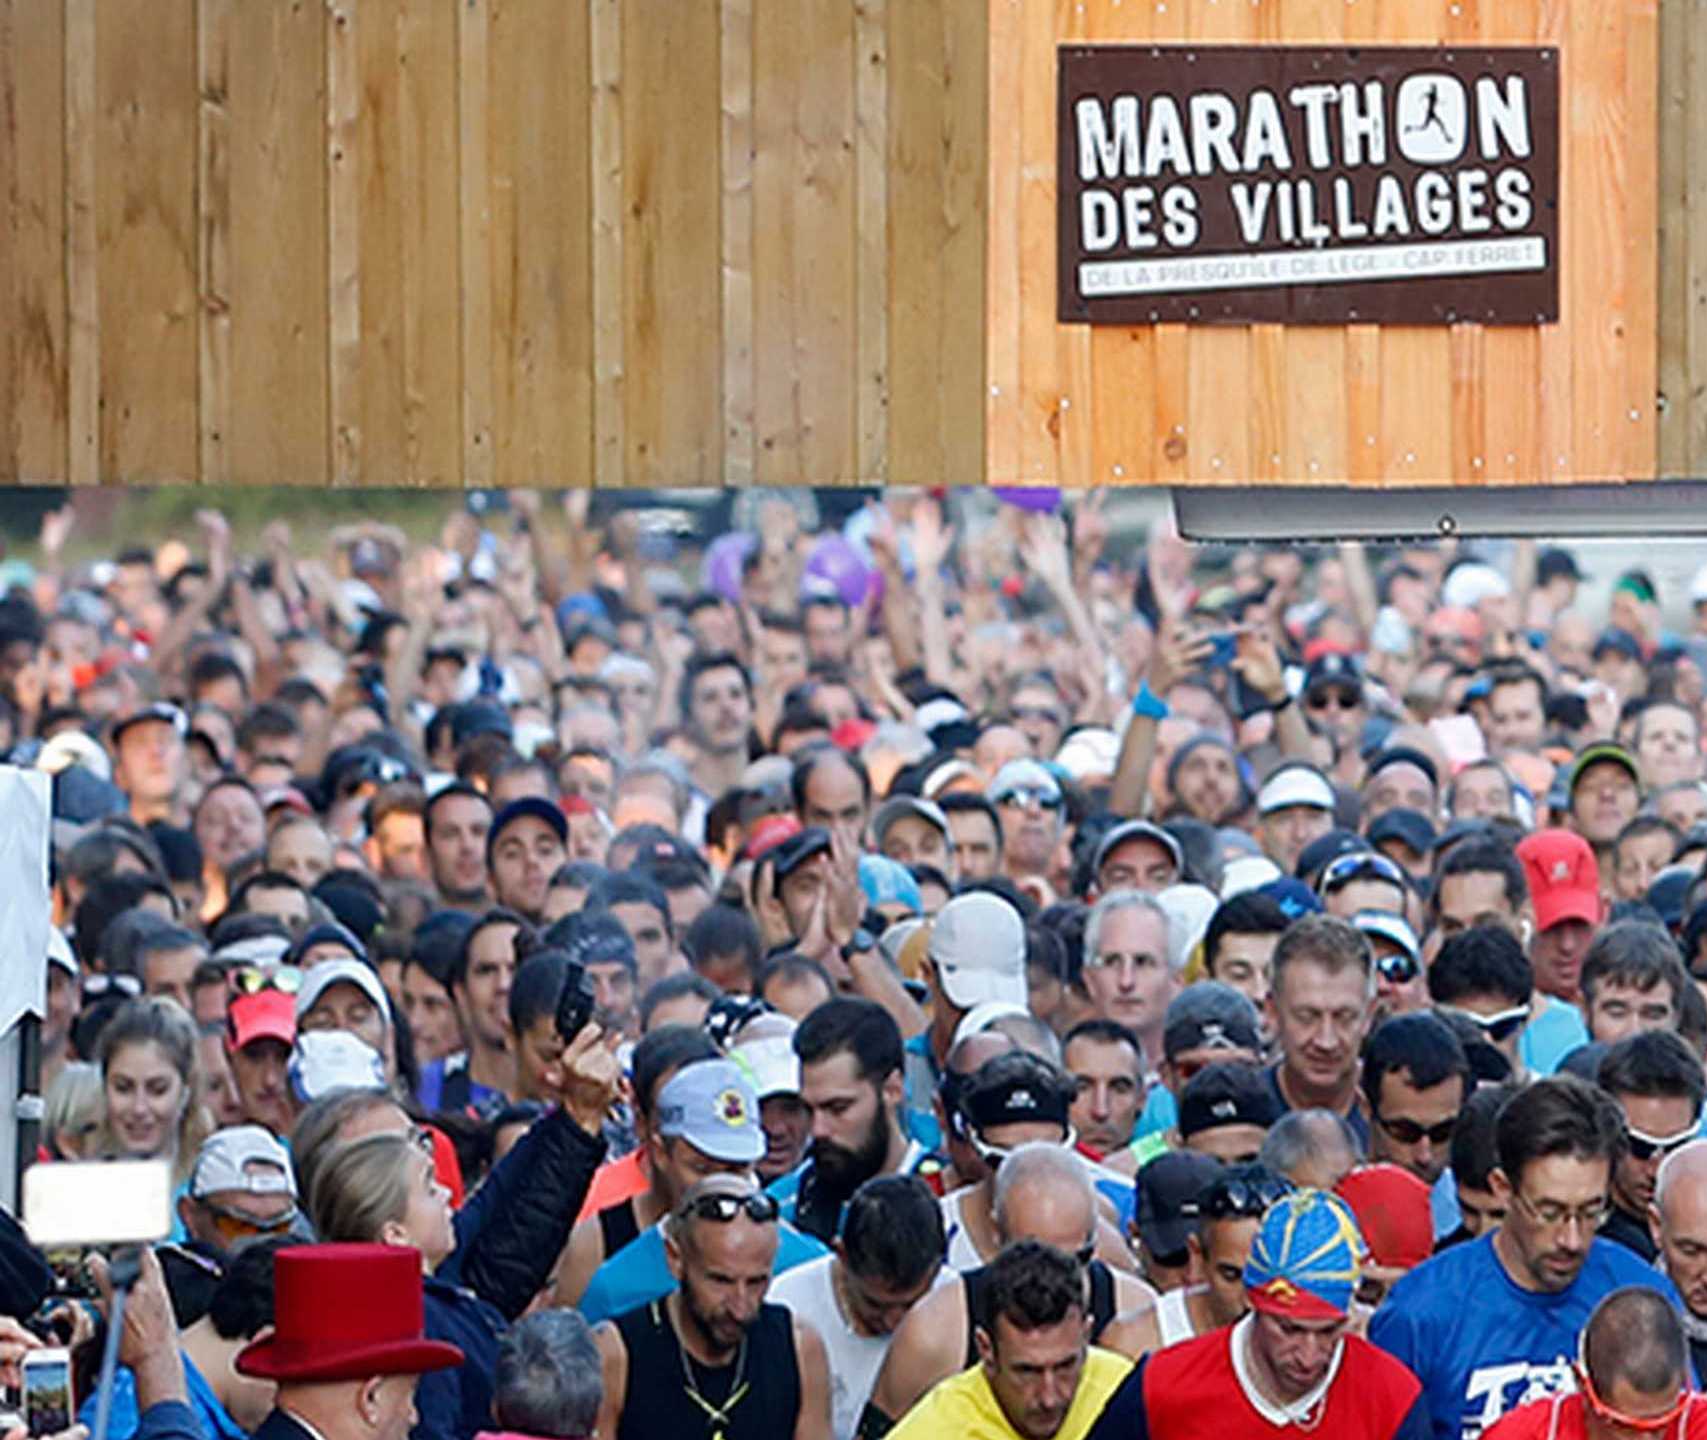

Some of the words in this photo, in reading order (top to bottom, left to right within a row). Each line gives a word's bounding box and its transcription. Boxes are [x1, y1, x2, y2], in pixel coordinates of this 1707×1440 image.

[1075, 73, 1532, 181] MARATHON
[1080, 185, 1199, 251] DES
[1230, 168, 1532, 245] VILLAGES
[1086, 268, 1114, 289] DE
[1122, 265, 1152, 286] LA
[1290, 255, 1321, 274] DE
[1402, 249, 1447, 269] CAP
[1454, 243, 1537, 265] FERRET
